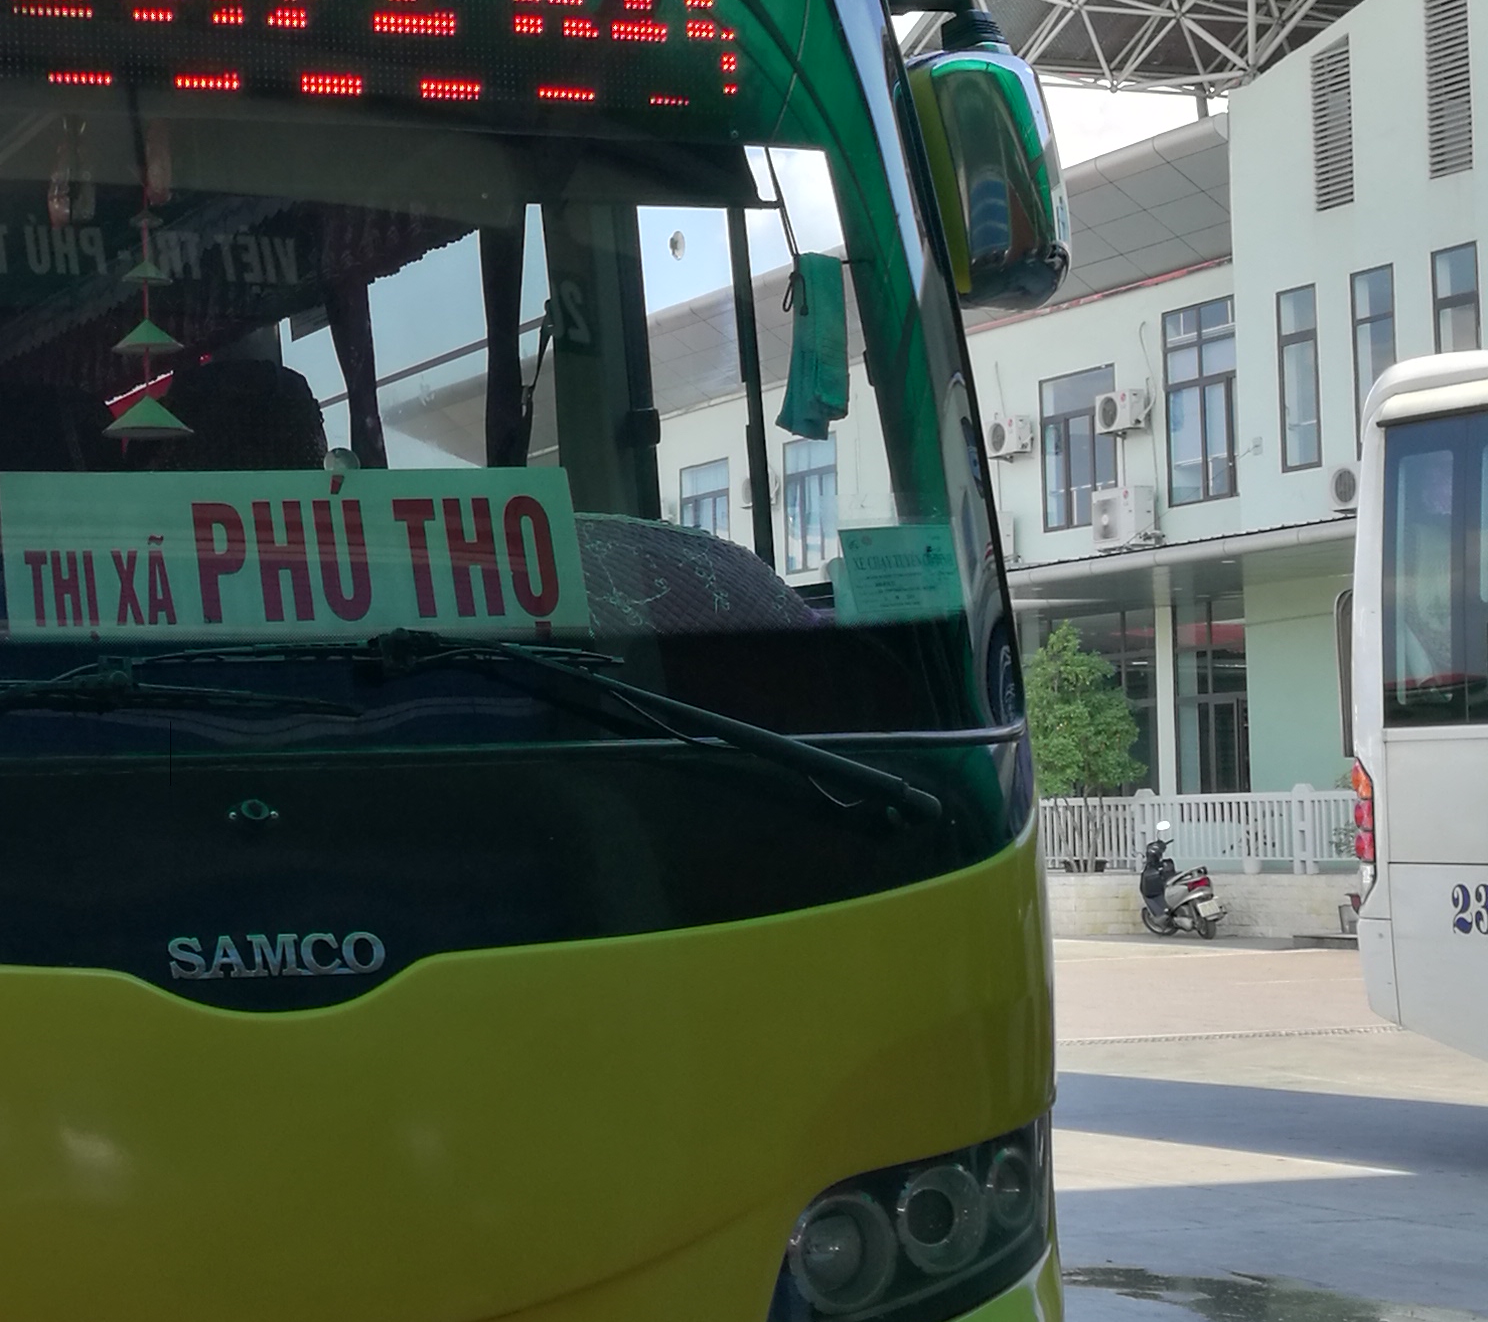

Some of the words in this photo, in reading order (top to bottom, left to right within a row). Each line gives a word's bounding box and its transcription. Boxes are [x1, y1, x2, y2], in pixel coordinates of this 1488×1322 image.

[111, 533, 178, 627] XÃ
[190, 473, 375, 625] PHÚ
[392, 493, 561, 639] THỌ
[166, 931, 387, 981] SAMCO
